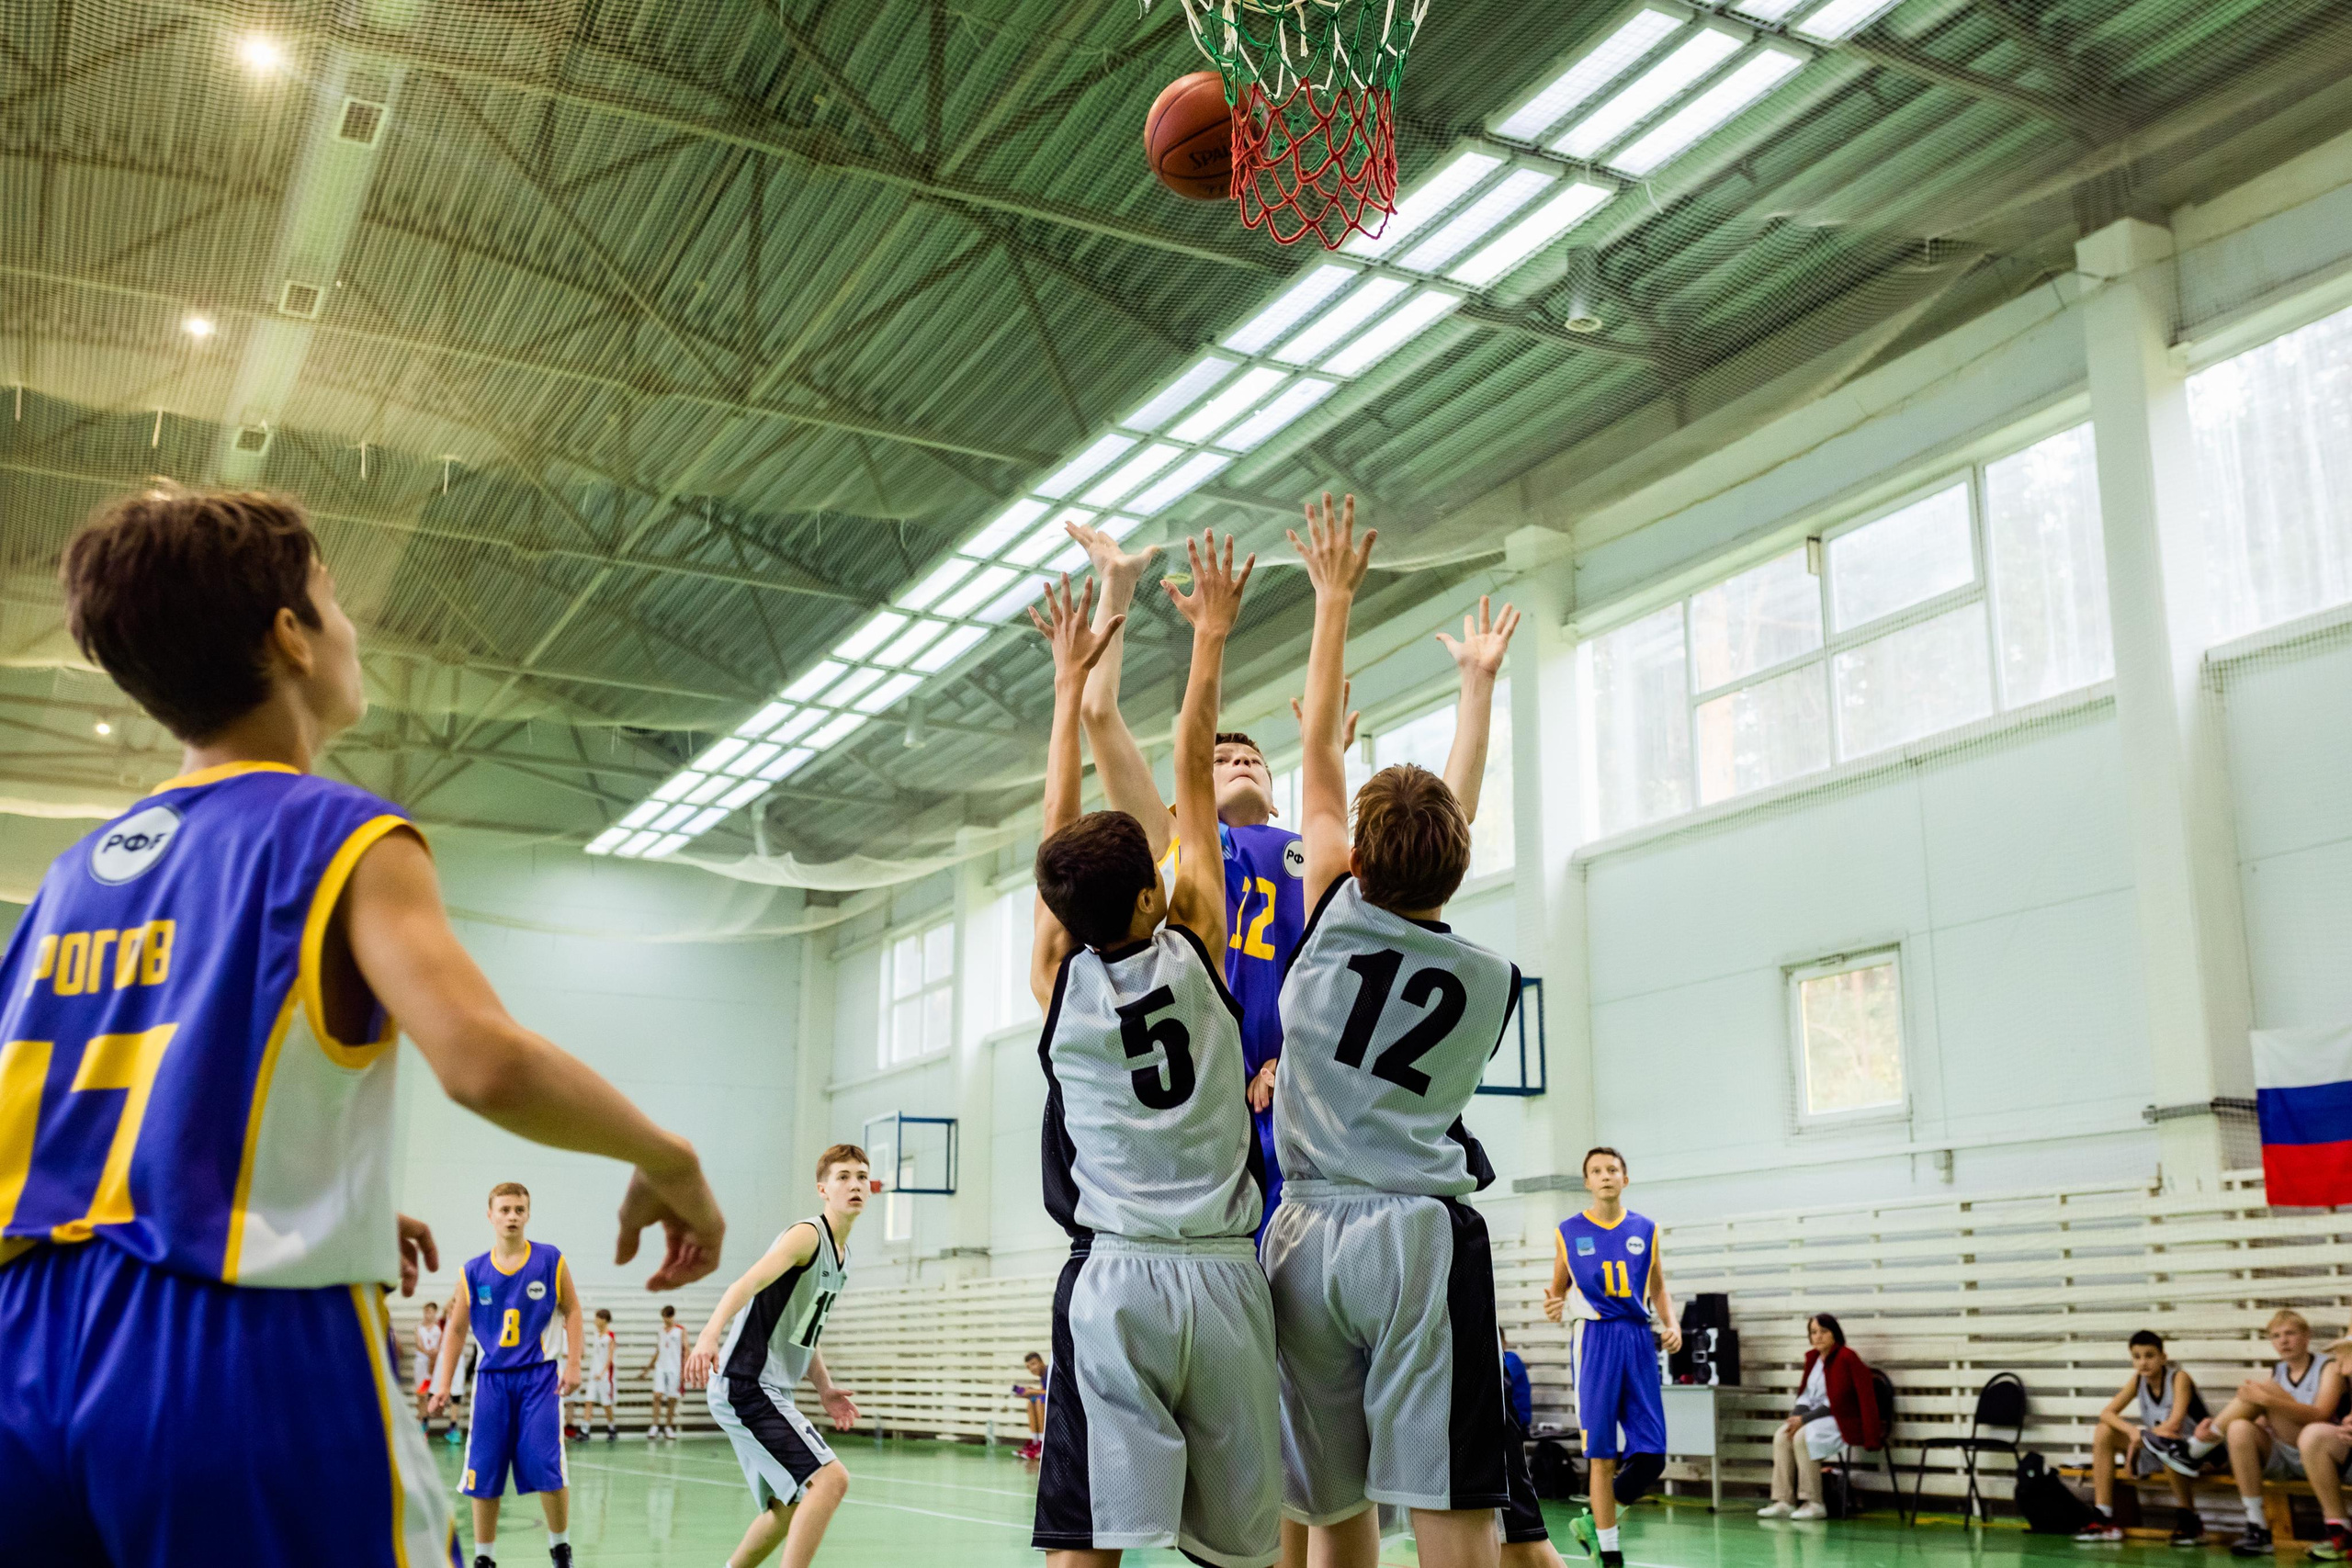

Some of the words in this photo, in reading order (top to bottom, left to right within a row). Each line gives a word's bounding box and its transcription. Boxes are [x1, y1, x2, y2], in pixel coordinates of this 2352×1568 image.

[1189, 145, 1232, 171] SPAL
[1286, 849, 1304, 864] РФ
[1228, 876, 1276, 961] 12
[1334, 948, 1467, 1097] 12
[1114, 985, 1195, 1110] 5
[1601, 1260, 1632, 1298] 11
[499, 1308, 520, 1347] 8
